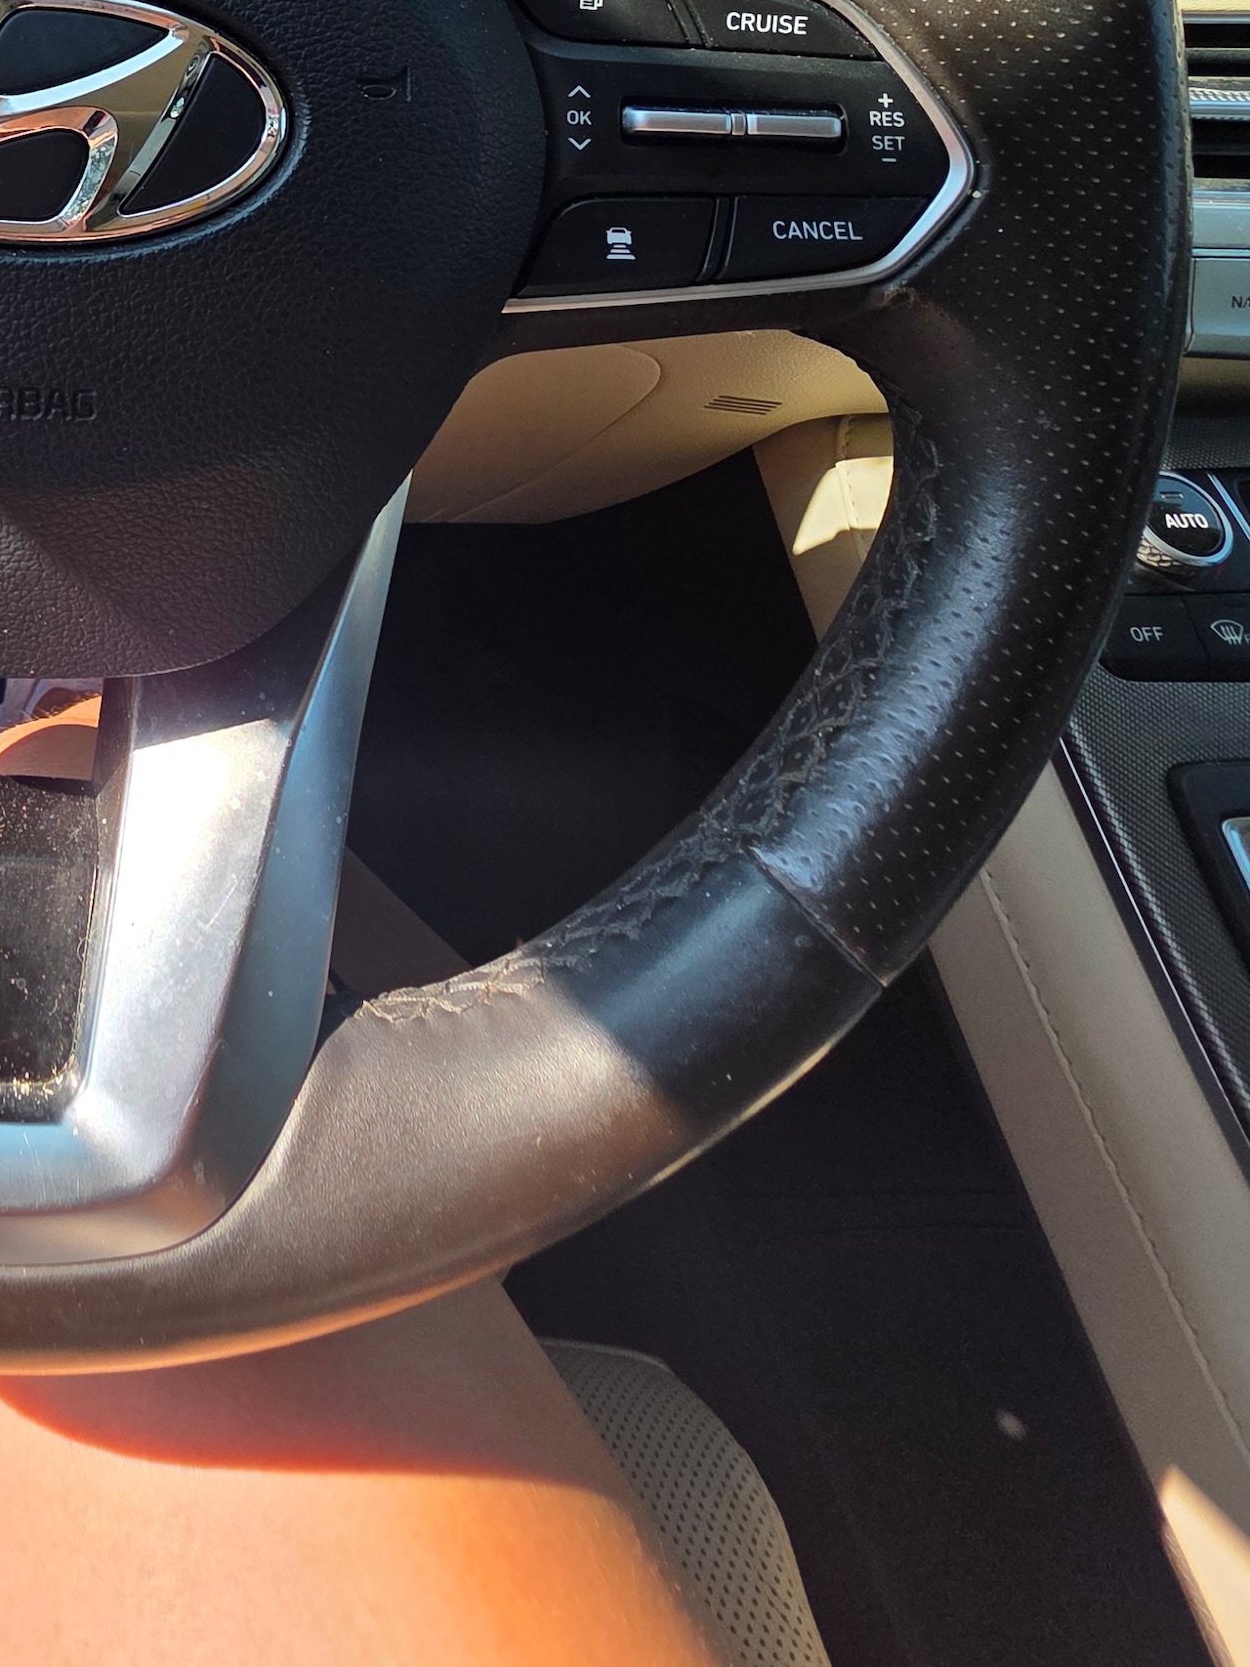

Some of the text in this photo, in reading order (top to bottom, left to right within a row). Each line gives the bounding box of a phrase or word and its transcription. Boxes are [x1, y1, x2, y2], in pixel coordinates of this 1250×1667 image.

[725, 11, 809, 35] CRUISE
[566, 110, 592, 126] OK
[869, 110, 905, 128] RES
[871, 135, 905, 151] SET
[772, 220, 863, 241] CANCEL
[1165, 514, 1208, 528] AUTO
[1129, 626, 1163, 642] OFF
